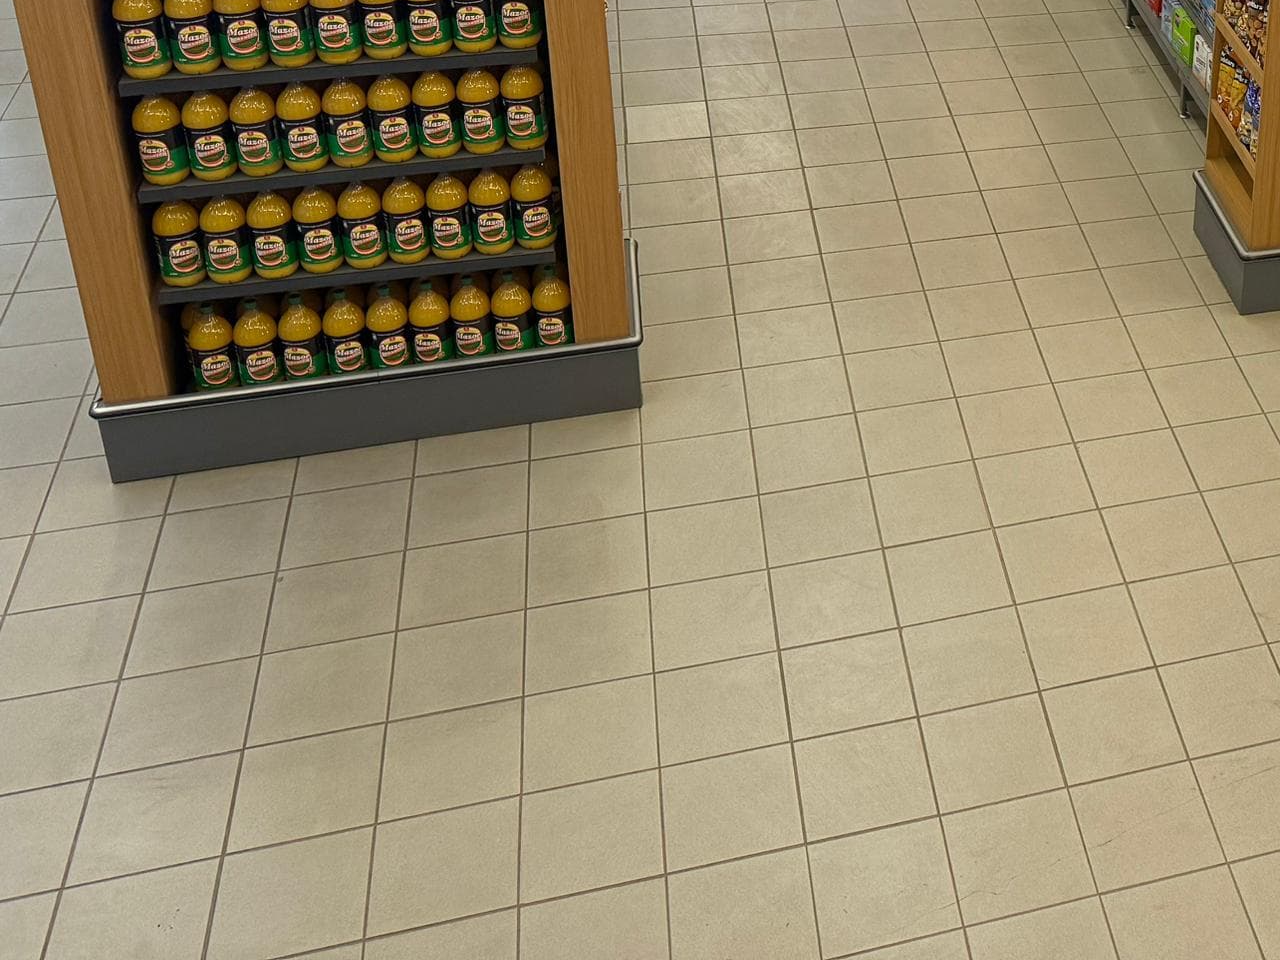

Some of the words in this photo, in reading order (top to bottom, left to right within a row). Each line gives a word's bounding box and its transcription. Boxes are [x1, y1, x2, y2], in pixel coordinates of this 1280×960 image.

[457, 13, 485, 22] Mazoe
[503, 9, 529, 18] Mazoe
[365, 19, 393, 27] Mazoe
[411, 15, 438, 24] Mazoe
[269, 25, 297, 34] Mazoe
[319, 22, 348, 30] Mazoe
[228, 27, 257, 36] Mazoe
[125, 36, 154, 45] Mazoe
[179, 32, 209, 41] Mazoe
[464, 115, 491, 124] Mazoe
[507, 112, 535, 121] Mazoe
[380, 125, 408, 133] Mazoe
[423, 120, 451, 129] Mazoe
[337, 127, 366, 137] Mazoe
[238, 137, 267, 146] Mazoe
[289, 134, 316, 143] Mazoe
[139, 146, 168, 154] Mazoe
[195, 142, 225, 151] Mazoe
[523, 214, 549, 223] Mazoe
[433, 223, 460, 232] Mazoe
[478, 219, 505, 228] Mazoe
[395, 226, 423, 235] Mazoe
[305, 236, 333, 244] Mazoe
[351, 231, 379, 240] Mazoe
[208, 245, 237, 254] Mazoe
[255, 241, 284, 250] Mazoe
[169, 247, 199, 257] Mazoe
